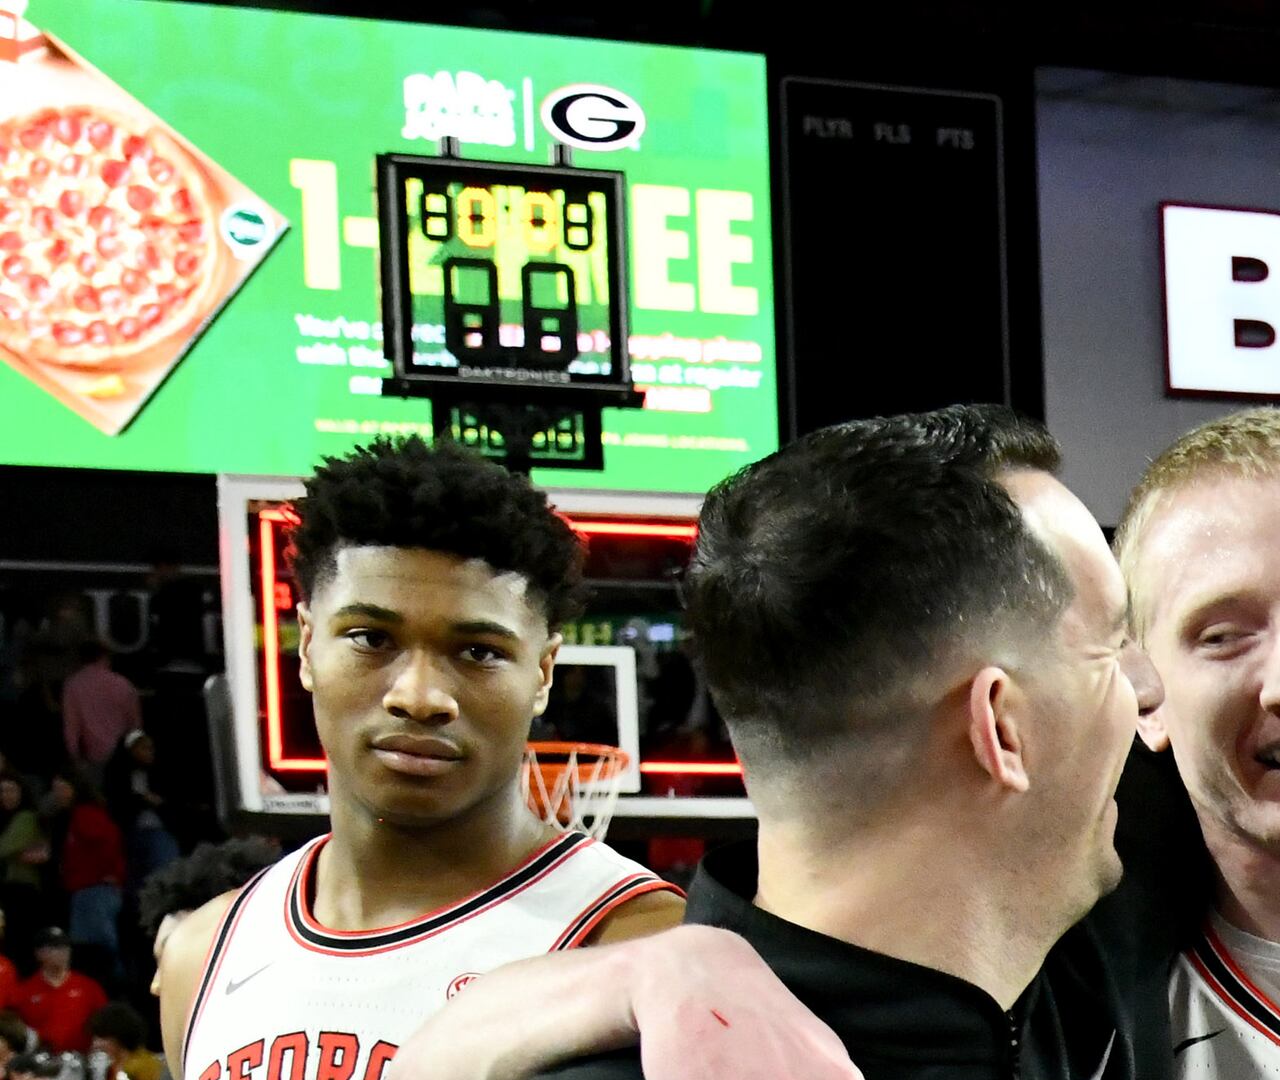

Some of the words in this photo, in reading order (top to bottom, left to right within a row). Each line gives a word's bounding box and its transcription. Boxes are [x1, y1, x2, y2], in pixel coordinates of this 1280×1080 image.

[551, 92, 636, 143] G
[801, 113, 855, 141] PLYR
[934, 127, 976, 151] PTS
